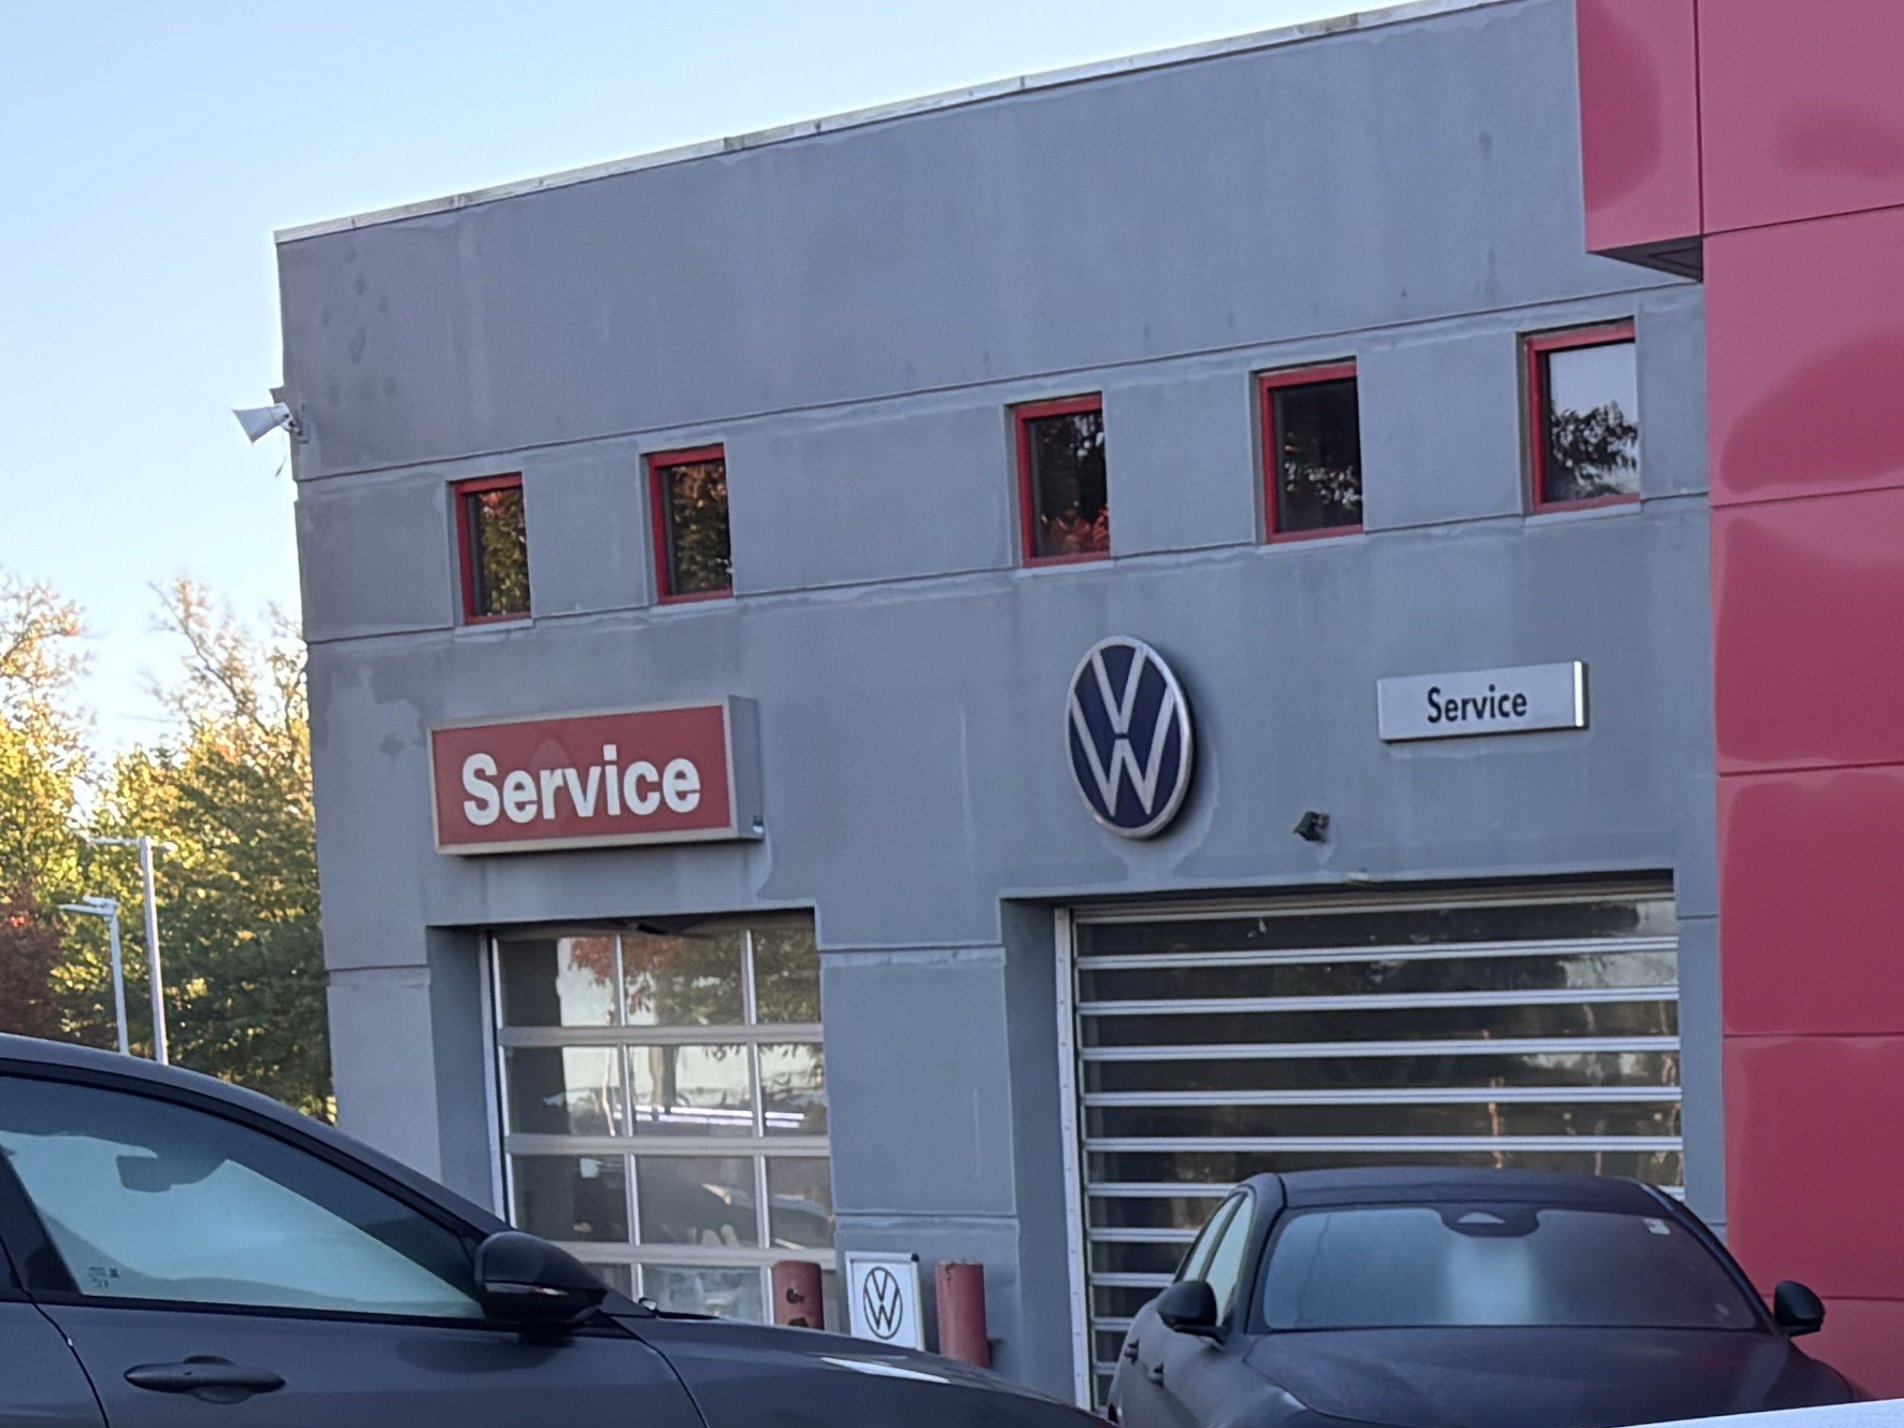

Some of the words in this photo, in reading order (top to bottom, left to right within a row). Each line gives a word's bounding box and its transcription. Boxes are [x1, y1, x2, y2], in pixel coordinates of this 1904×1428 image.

[1068, 640, 1184, 828] VW
[1427, 684, 1528, 724] Service
[461, 743, 701, 827] Service
[864, 1267, 902, 1337] VW
